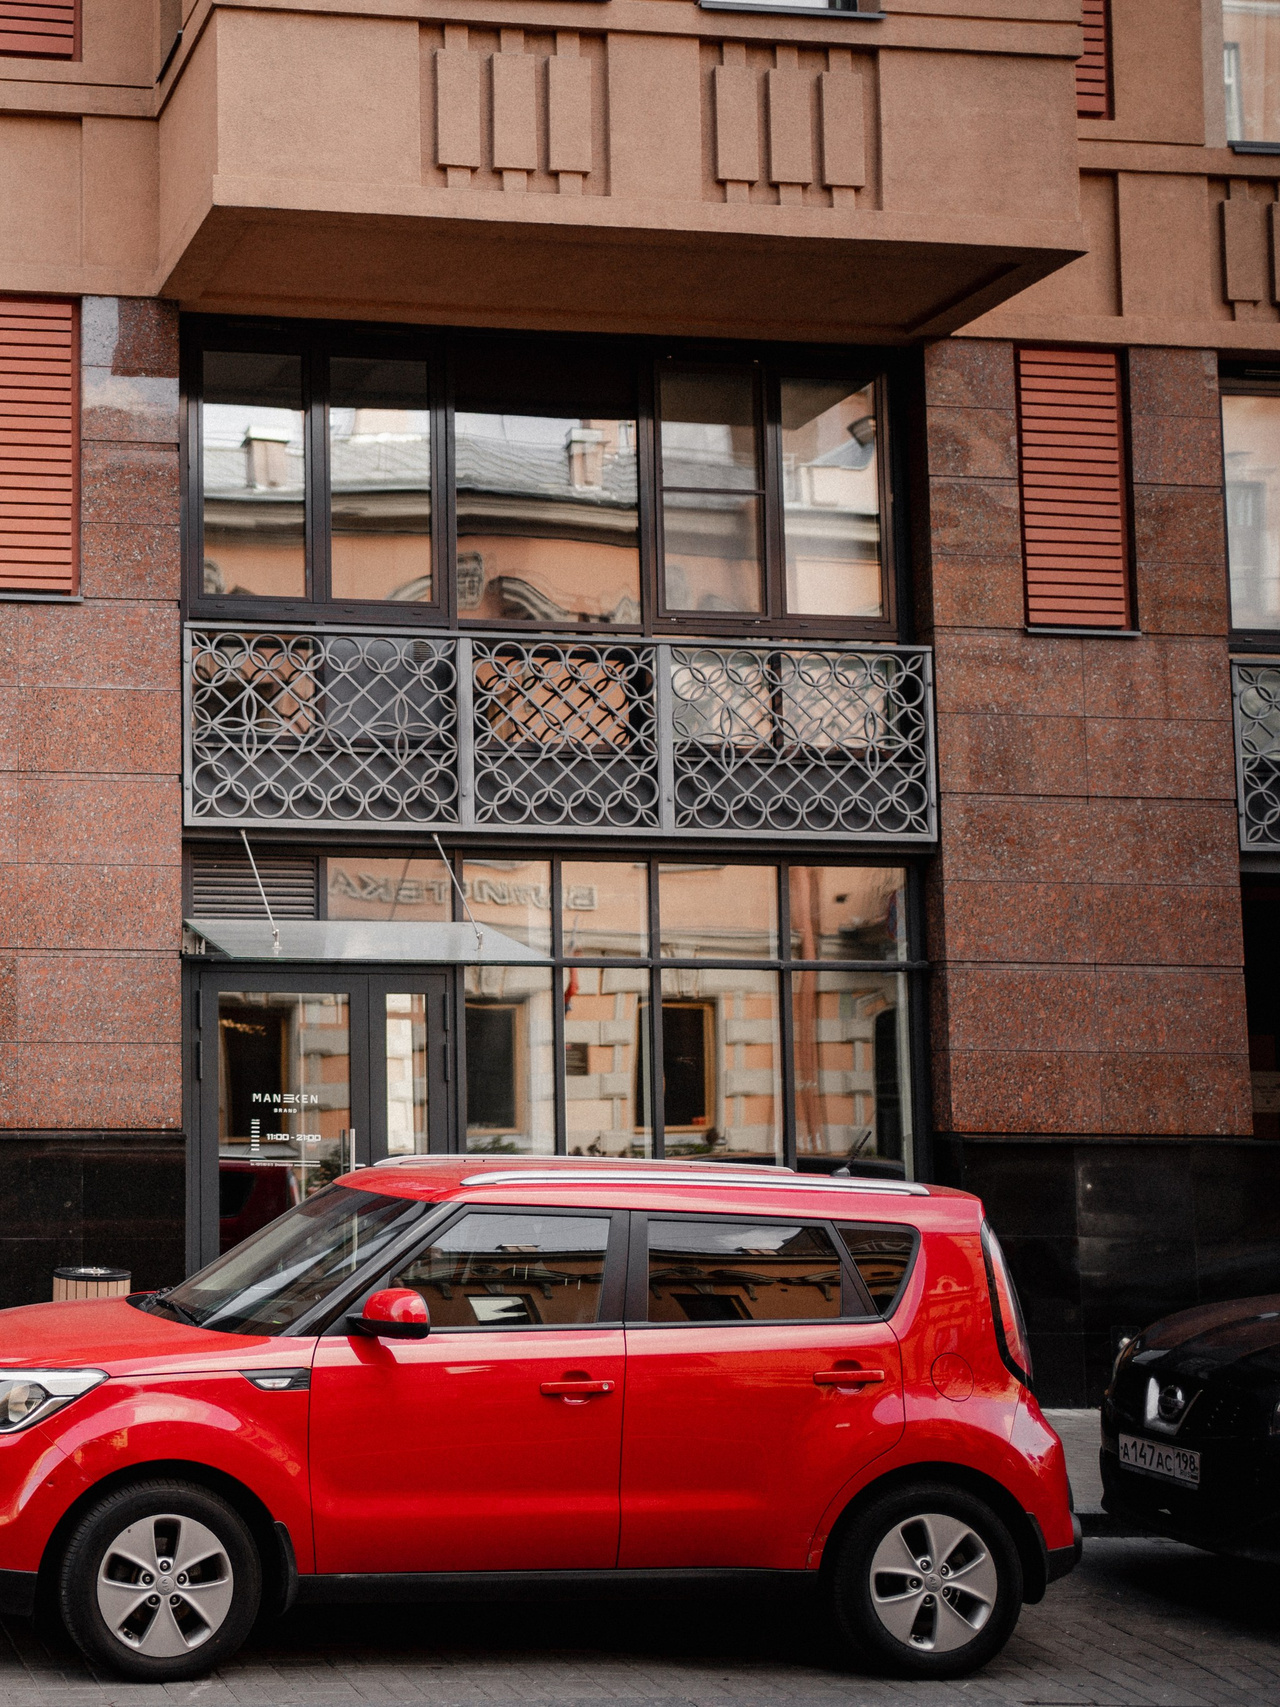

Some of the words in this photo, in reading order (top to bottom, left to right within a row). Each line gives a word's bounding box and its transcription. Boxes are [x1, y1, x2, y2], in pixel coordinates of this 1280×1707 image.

[252, 1093, 319, 1104] MANEKEN
[266, 1133, 290, 1141] 11:00
[296, 1134, 322, 1142] 21:00
